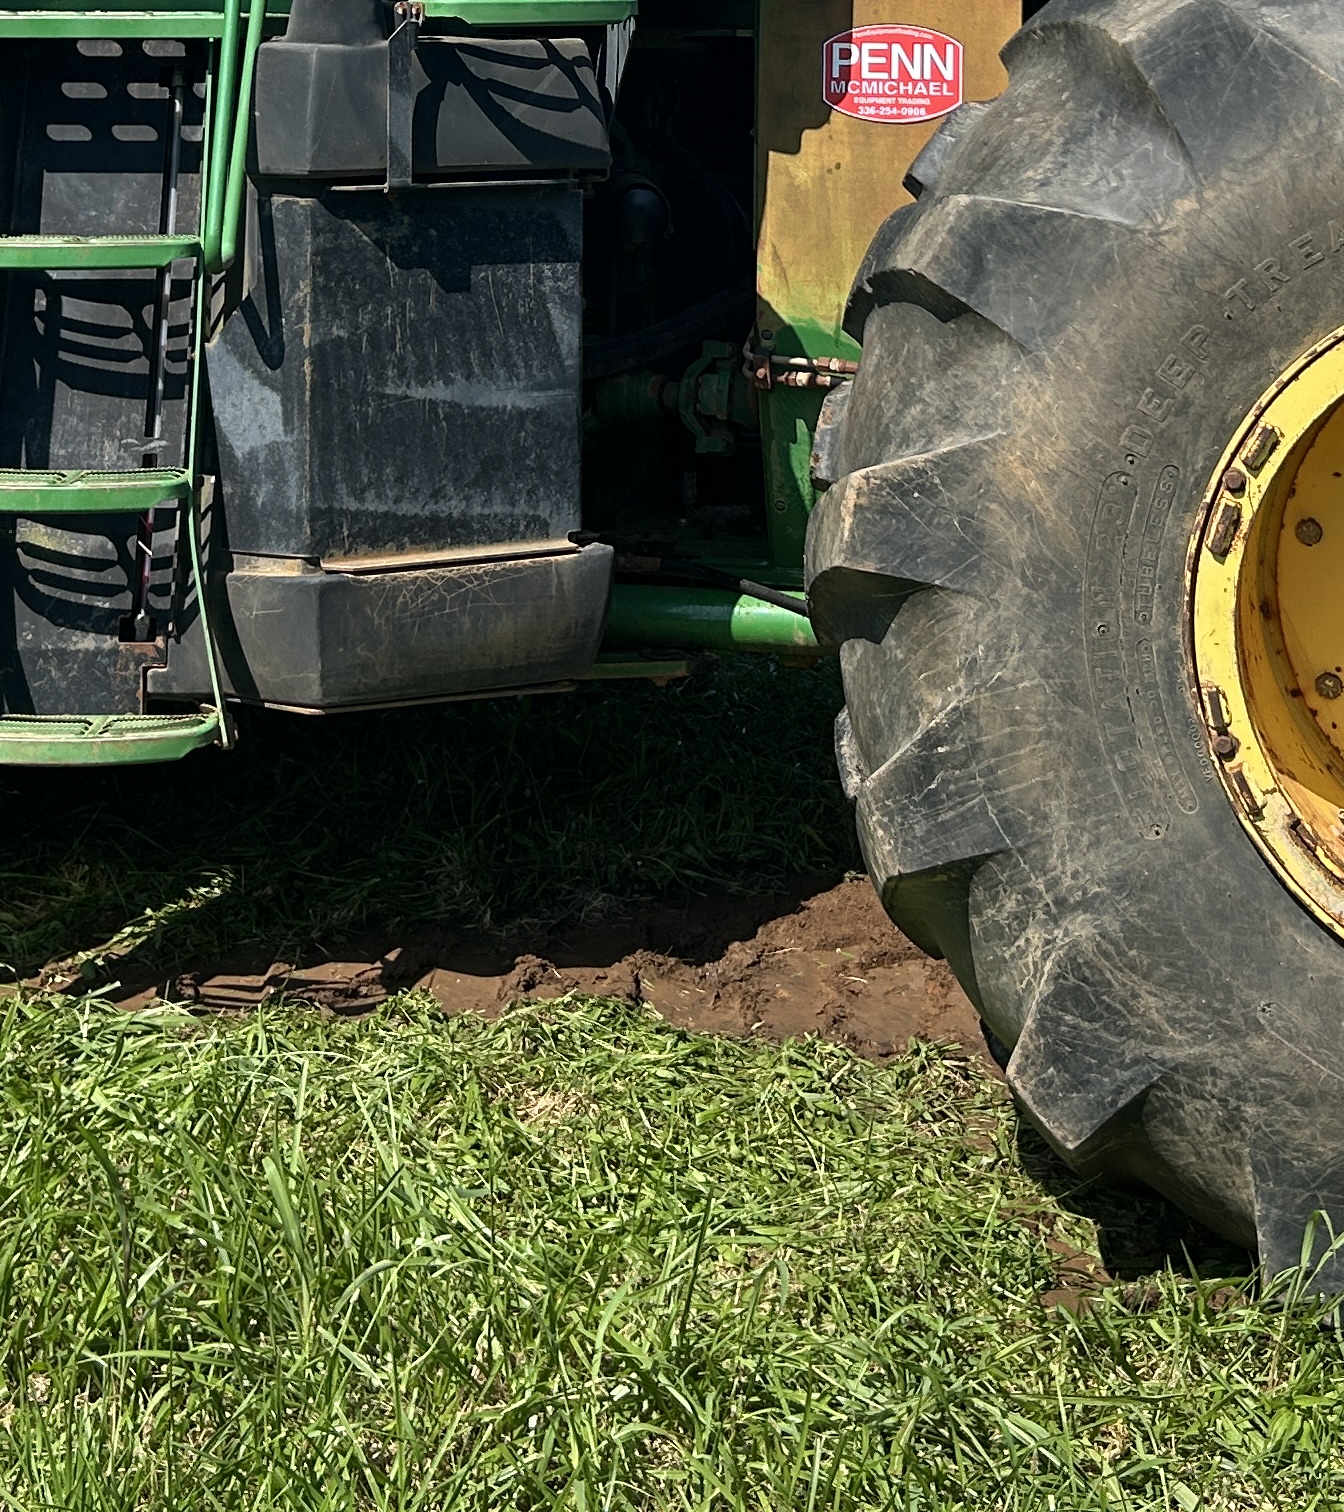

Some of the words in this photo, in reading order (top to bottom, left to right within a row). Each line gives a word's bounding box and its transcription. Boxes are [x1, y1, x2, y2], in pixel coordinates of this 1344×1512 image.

[831, 42, 954, 80] PENN
[830, 80, 954, 96] MCMICHAEL
[853, 96, 896, 104] EQUIPMENT
[897, 97, 931, 105] TRADING
[1118, 323, 1213, 458] DEEP
